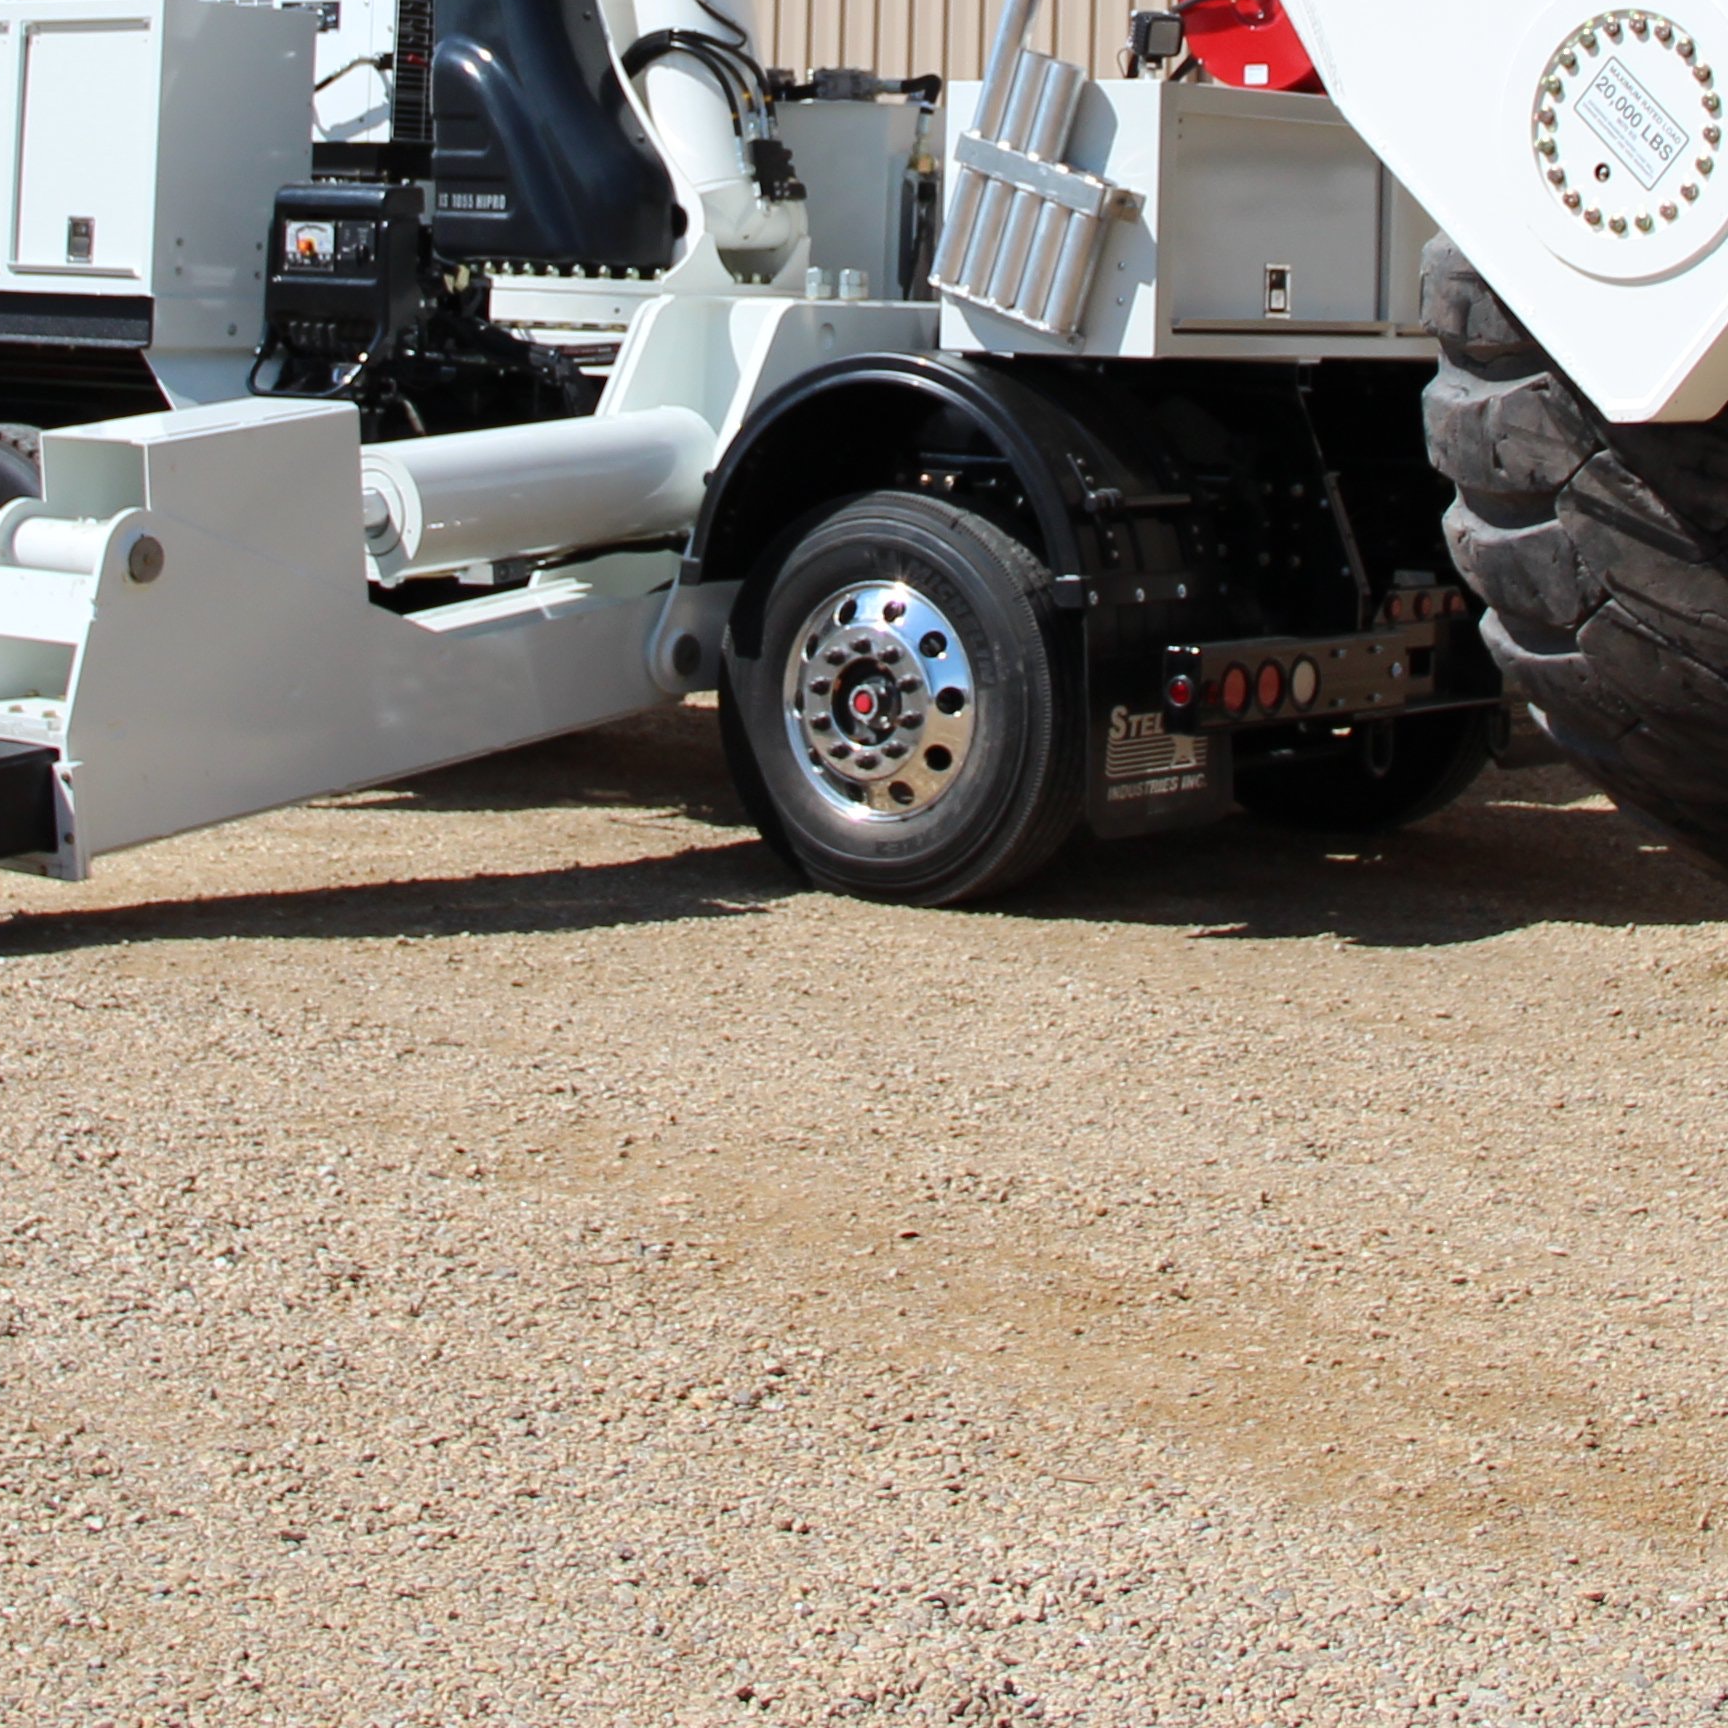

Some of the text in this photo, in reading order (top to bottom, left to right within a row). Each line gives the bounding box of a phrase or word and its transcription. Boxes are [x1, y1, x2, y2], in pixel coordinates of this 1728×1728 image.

[1595, 75, 1643, 128] 20,000
[1641, 124, 1674, 161] LBS
[1609, 65, 1643, 102] MAXIMUM
[1640, 100, 1664, 126] RATED
[1661, 122, 1682, 145] LOAD
[1109, 705, 1164, 739] STEL
[1107, 776, 1179, 802] INDUSTRIES
